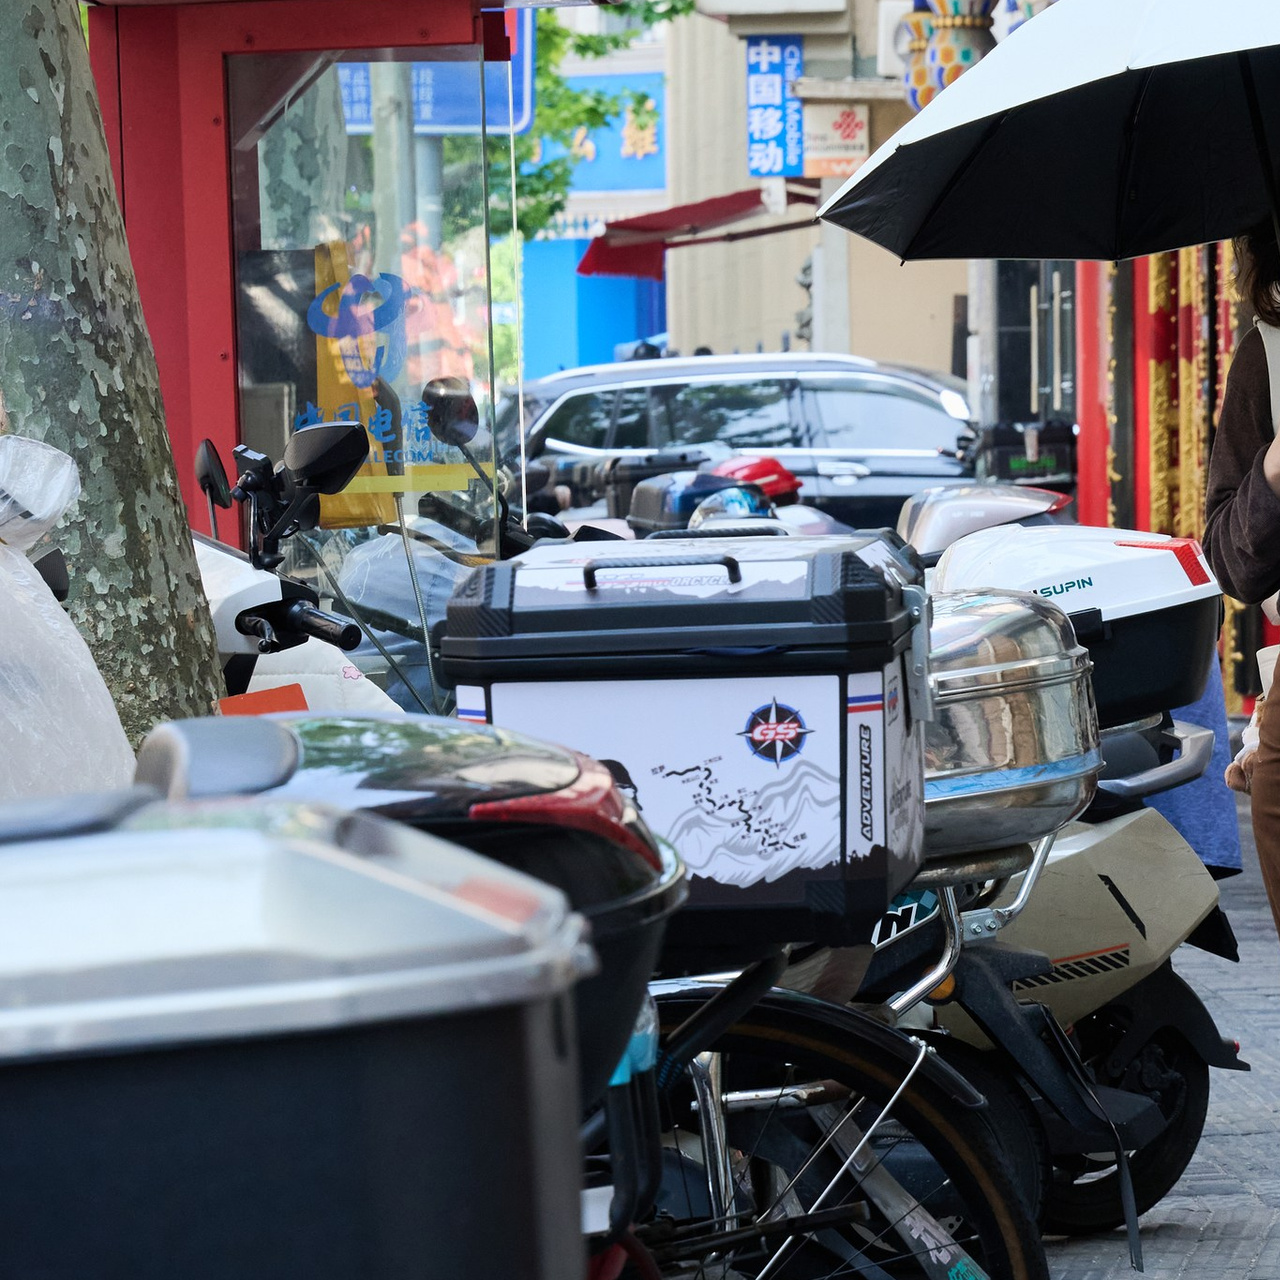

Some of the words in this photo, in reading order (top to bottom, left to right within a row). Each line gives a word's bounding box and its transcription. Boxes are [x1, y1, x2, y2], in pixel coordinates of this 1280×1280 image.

[750, 40, 784, 174] 中国移动
[752, 722, 799, 741] GS
[859, 723, 873, 842] ADVENTURE
